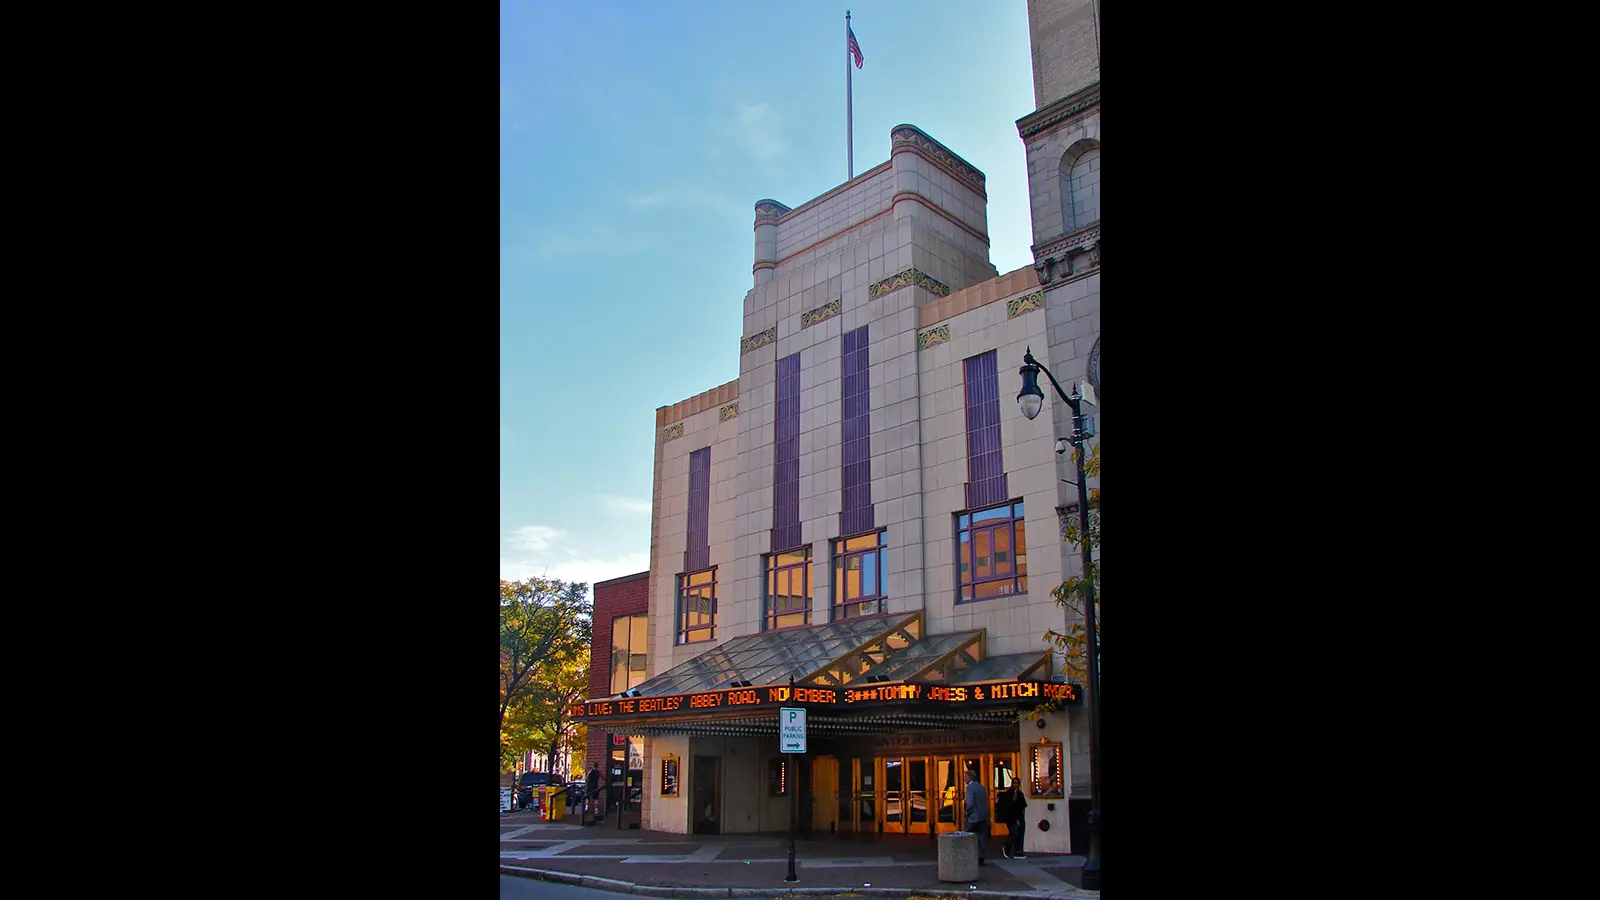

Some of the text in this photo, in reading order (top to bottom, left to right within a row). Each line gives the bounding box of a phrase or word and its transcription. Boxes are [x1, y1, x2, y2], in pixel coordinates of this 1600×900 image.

[588, 702, 612, 716] LIVE:
[619, 701, 635, 713] THE
[639, 697, 683, 712] BEATLES'
[690, 694, 723, 708] ABBEY
[728, 690, 760, 705] ROAD,
[974, 686, 985, 700] &
[991, 683, 1038, 699] MITCH
[789, 711, 797, 723] P
[783, 732, 805, 740] PARKING
